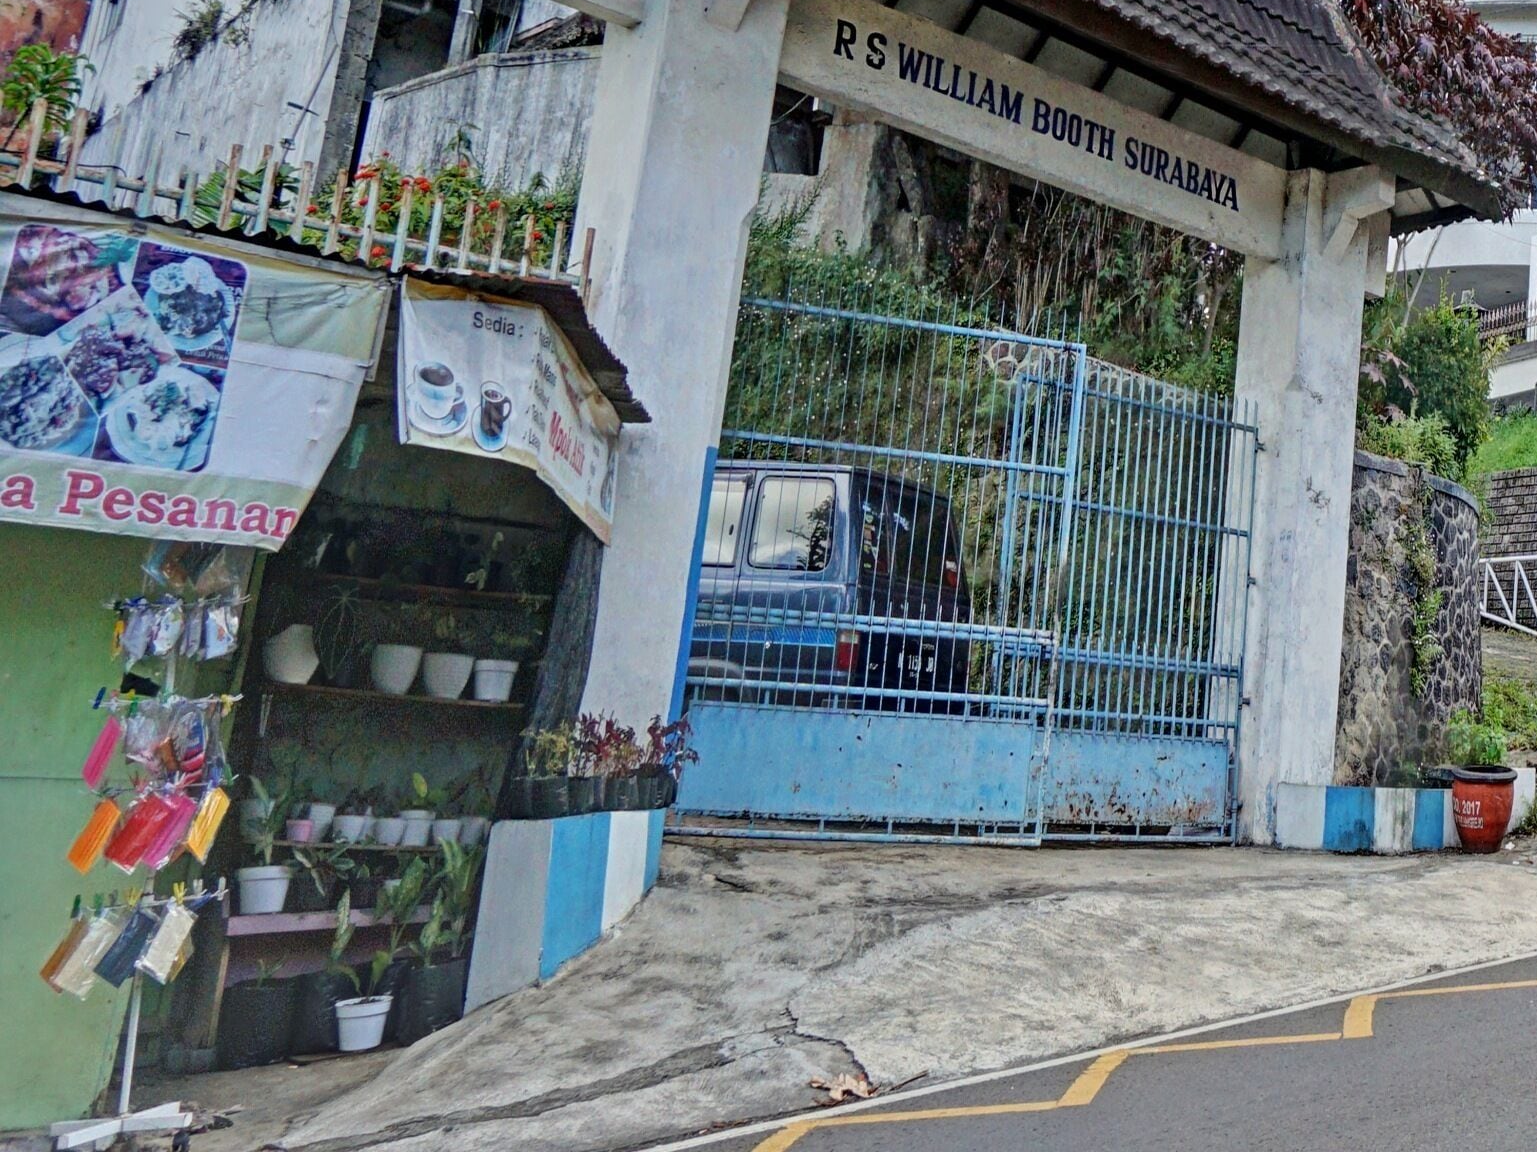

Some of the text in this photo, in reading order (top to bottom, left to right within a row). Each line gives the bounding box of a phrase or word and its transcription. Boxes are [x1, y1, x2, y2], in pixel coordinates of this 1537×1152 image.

[898, 42, 1025, 125] WILLIAM
[1032, 97, 1116, 161] BOOTH
[1124, 136, 1240, 212] SURABAYA
[59, 470, 298, 539] Pesanan
[1462, 799, 1481, 816] 2017
